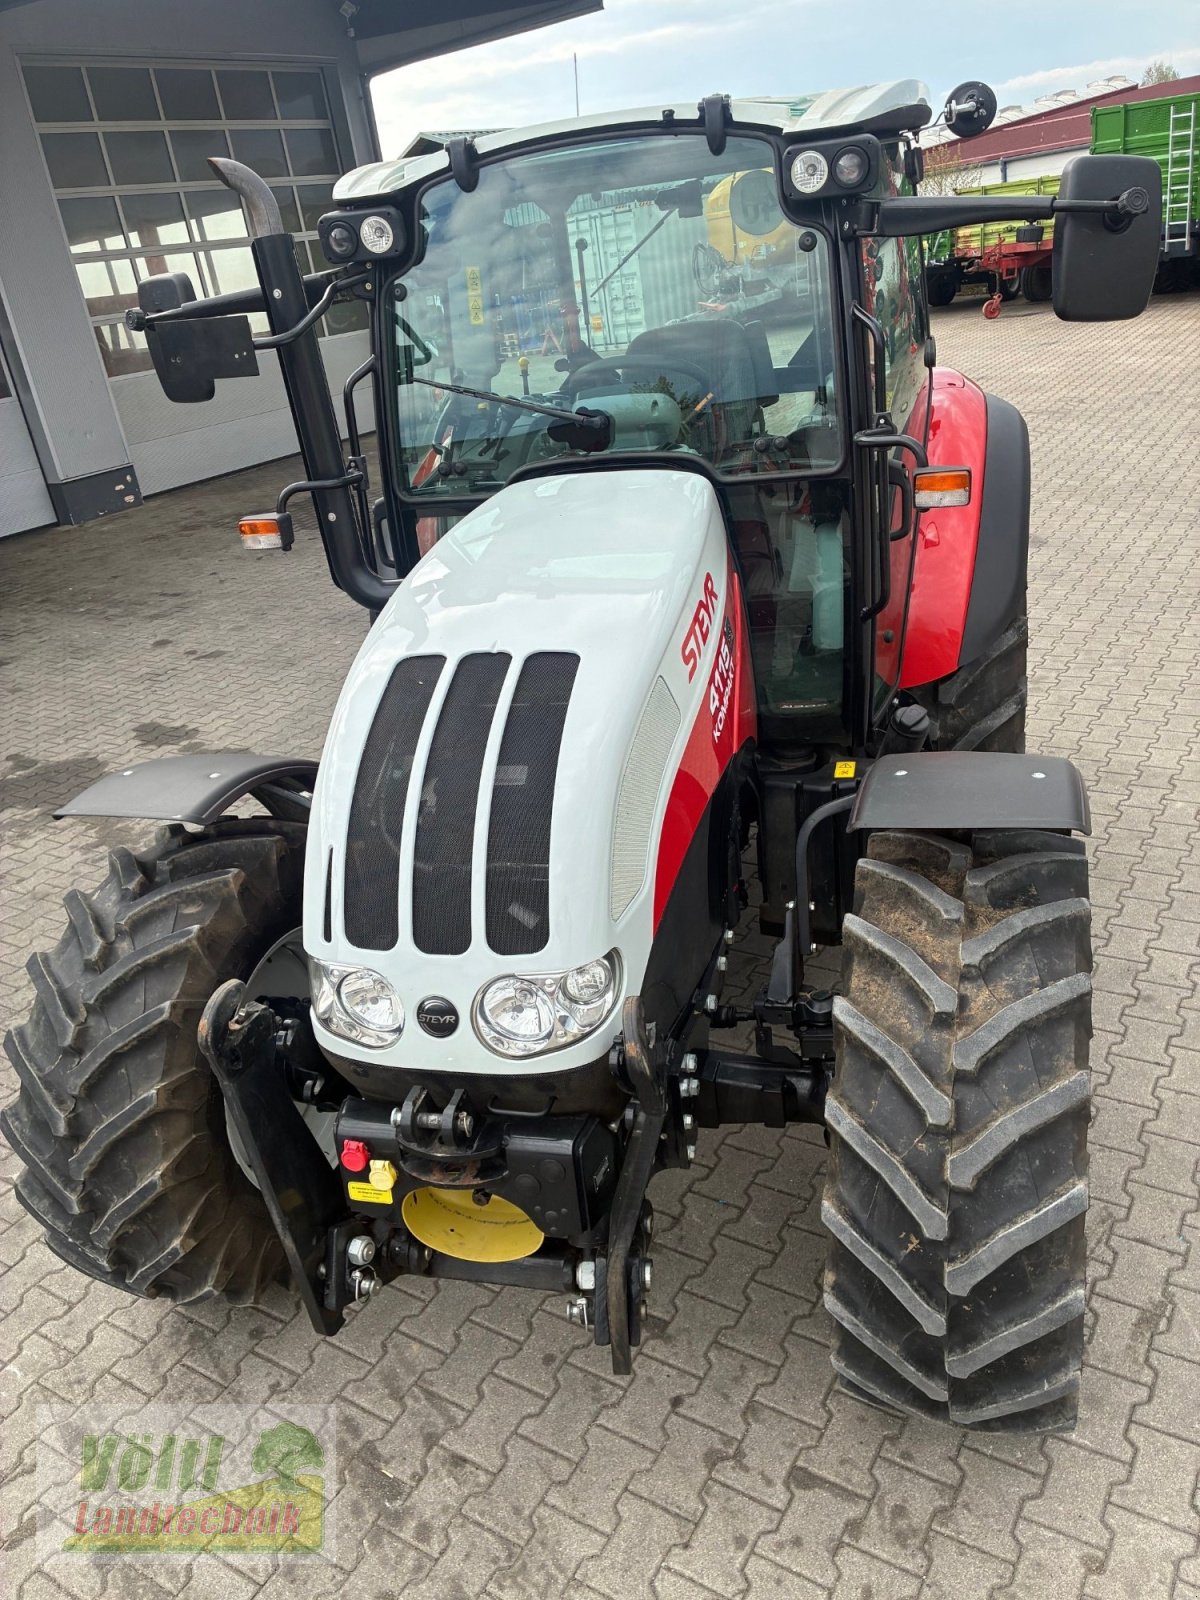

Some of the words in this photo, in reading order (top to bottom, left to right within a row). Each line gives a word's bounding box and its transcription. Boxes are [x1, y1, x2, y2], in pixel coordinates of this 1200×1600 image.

[681, 571, 718, 684] STEYR
[709, 635, 730, 715] 4115
[418, 1013, 456, 1024] STEYR
